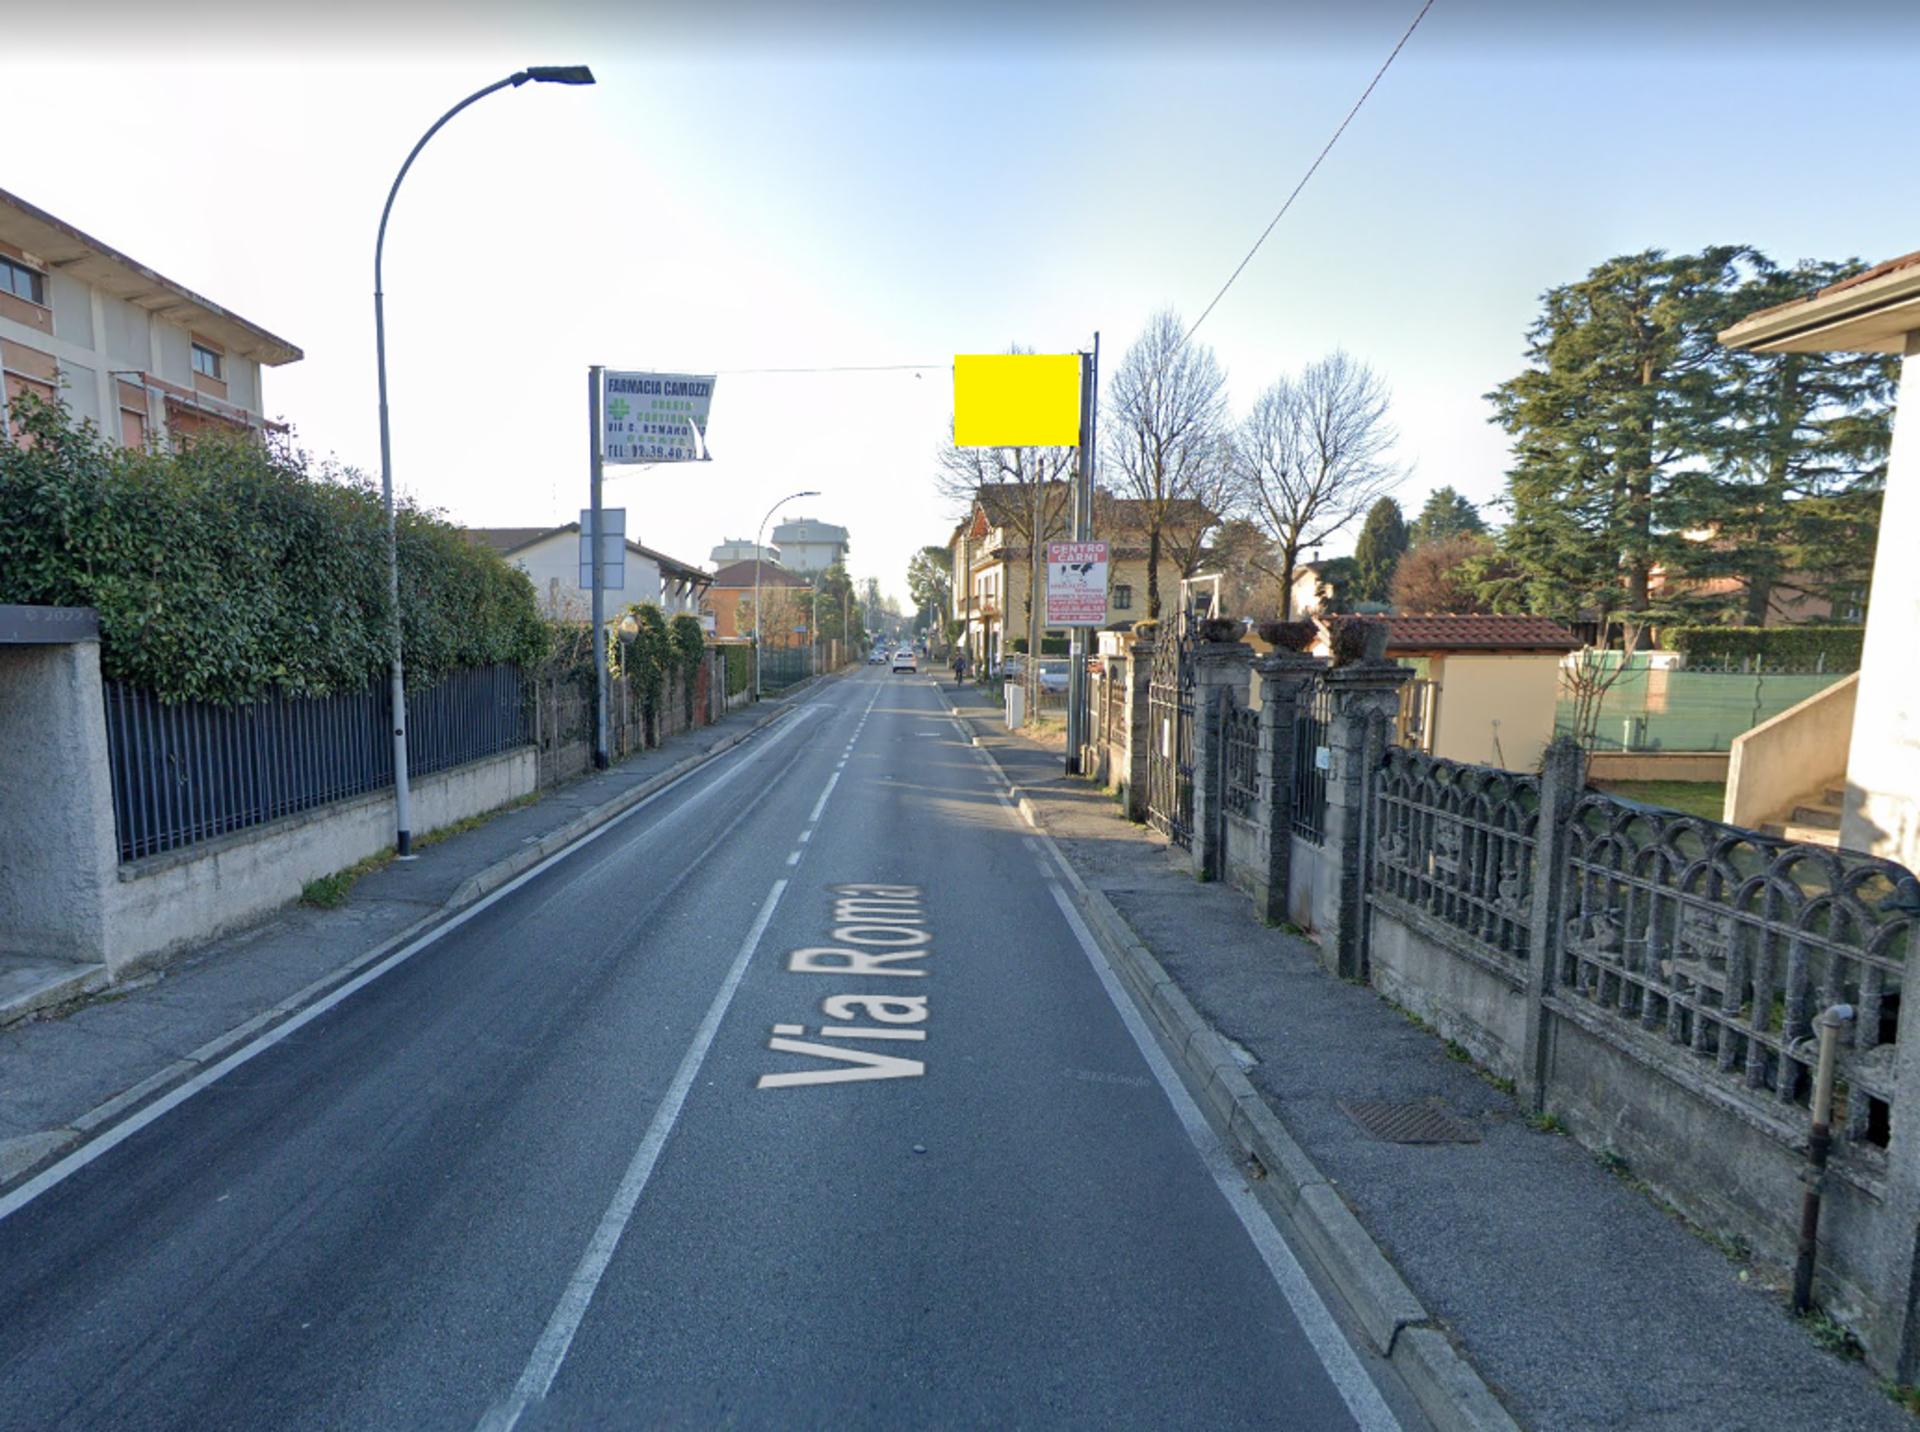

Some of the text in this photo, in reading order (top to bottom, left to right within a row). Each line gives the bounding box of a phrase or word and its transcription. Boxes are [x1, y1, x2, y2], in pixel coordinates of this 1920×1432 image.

[608, 379, 710, 398] FARMACIA CAMOZZI
[1052, 543, 1104, 554] CENTRO
[1058, 553, 1098, 562] CARNI
[756, 995, 928, 1089] Via
